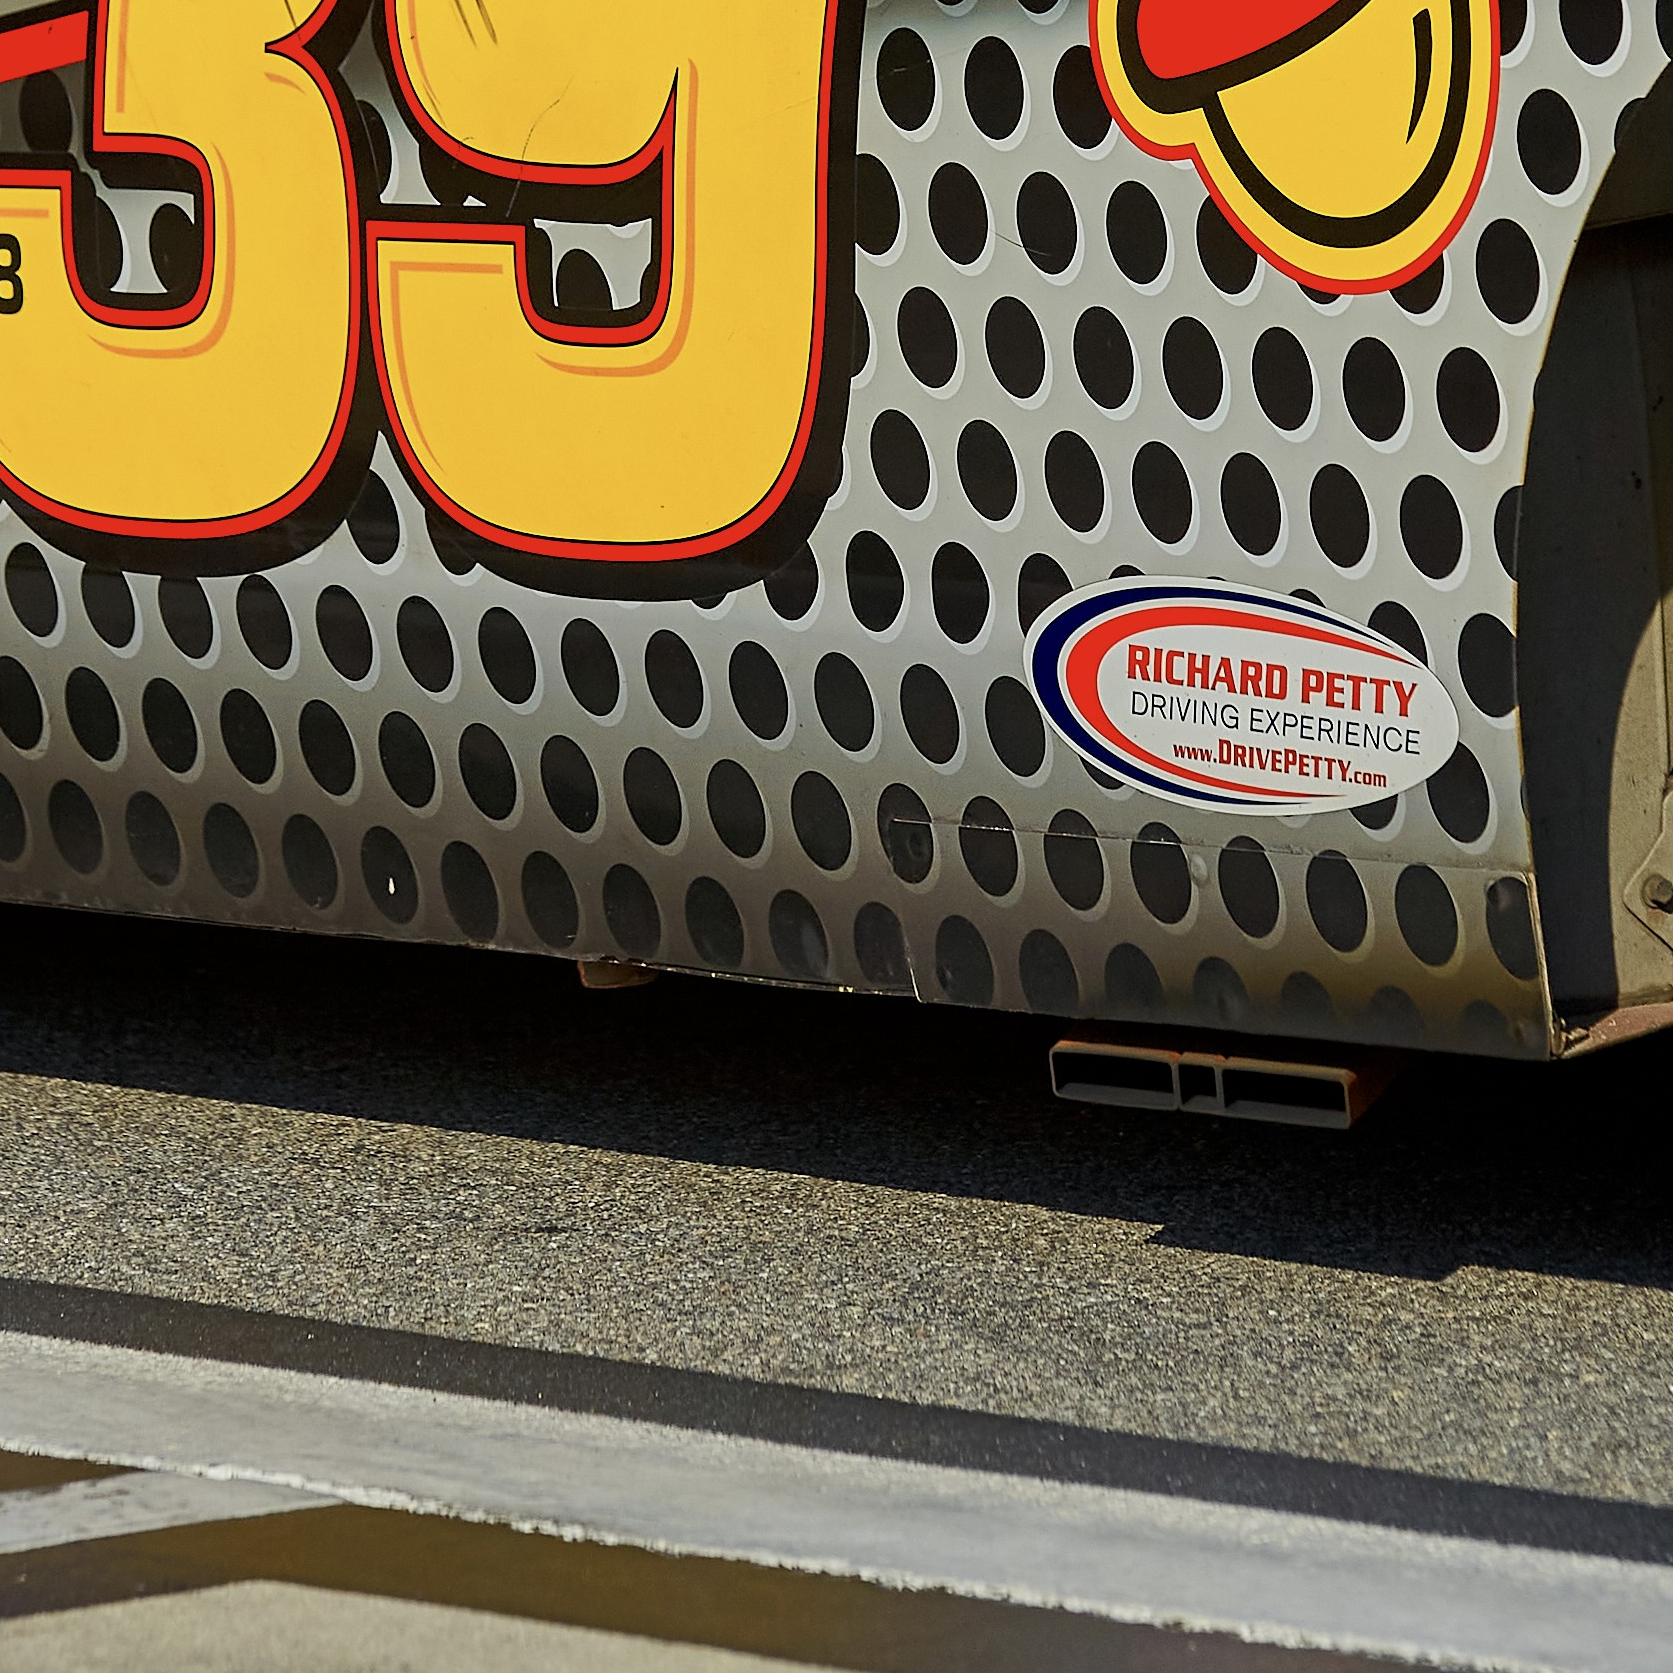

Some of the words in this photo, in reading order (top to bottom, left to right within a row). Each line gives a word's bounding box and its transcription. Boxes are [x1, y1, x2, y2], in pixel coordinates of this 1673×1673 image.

[1126, 643, 1289, 701] RICHARD
[1299, 668, 1420, 718] PETTY
[1130, 690, 1240, 731] DRIVING
[1249, 707, 1422, 756] EXPERIENCE
